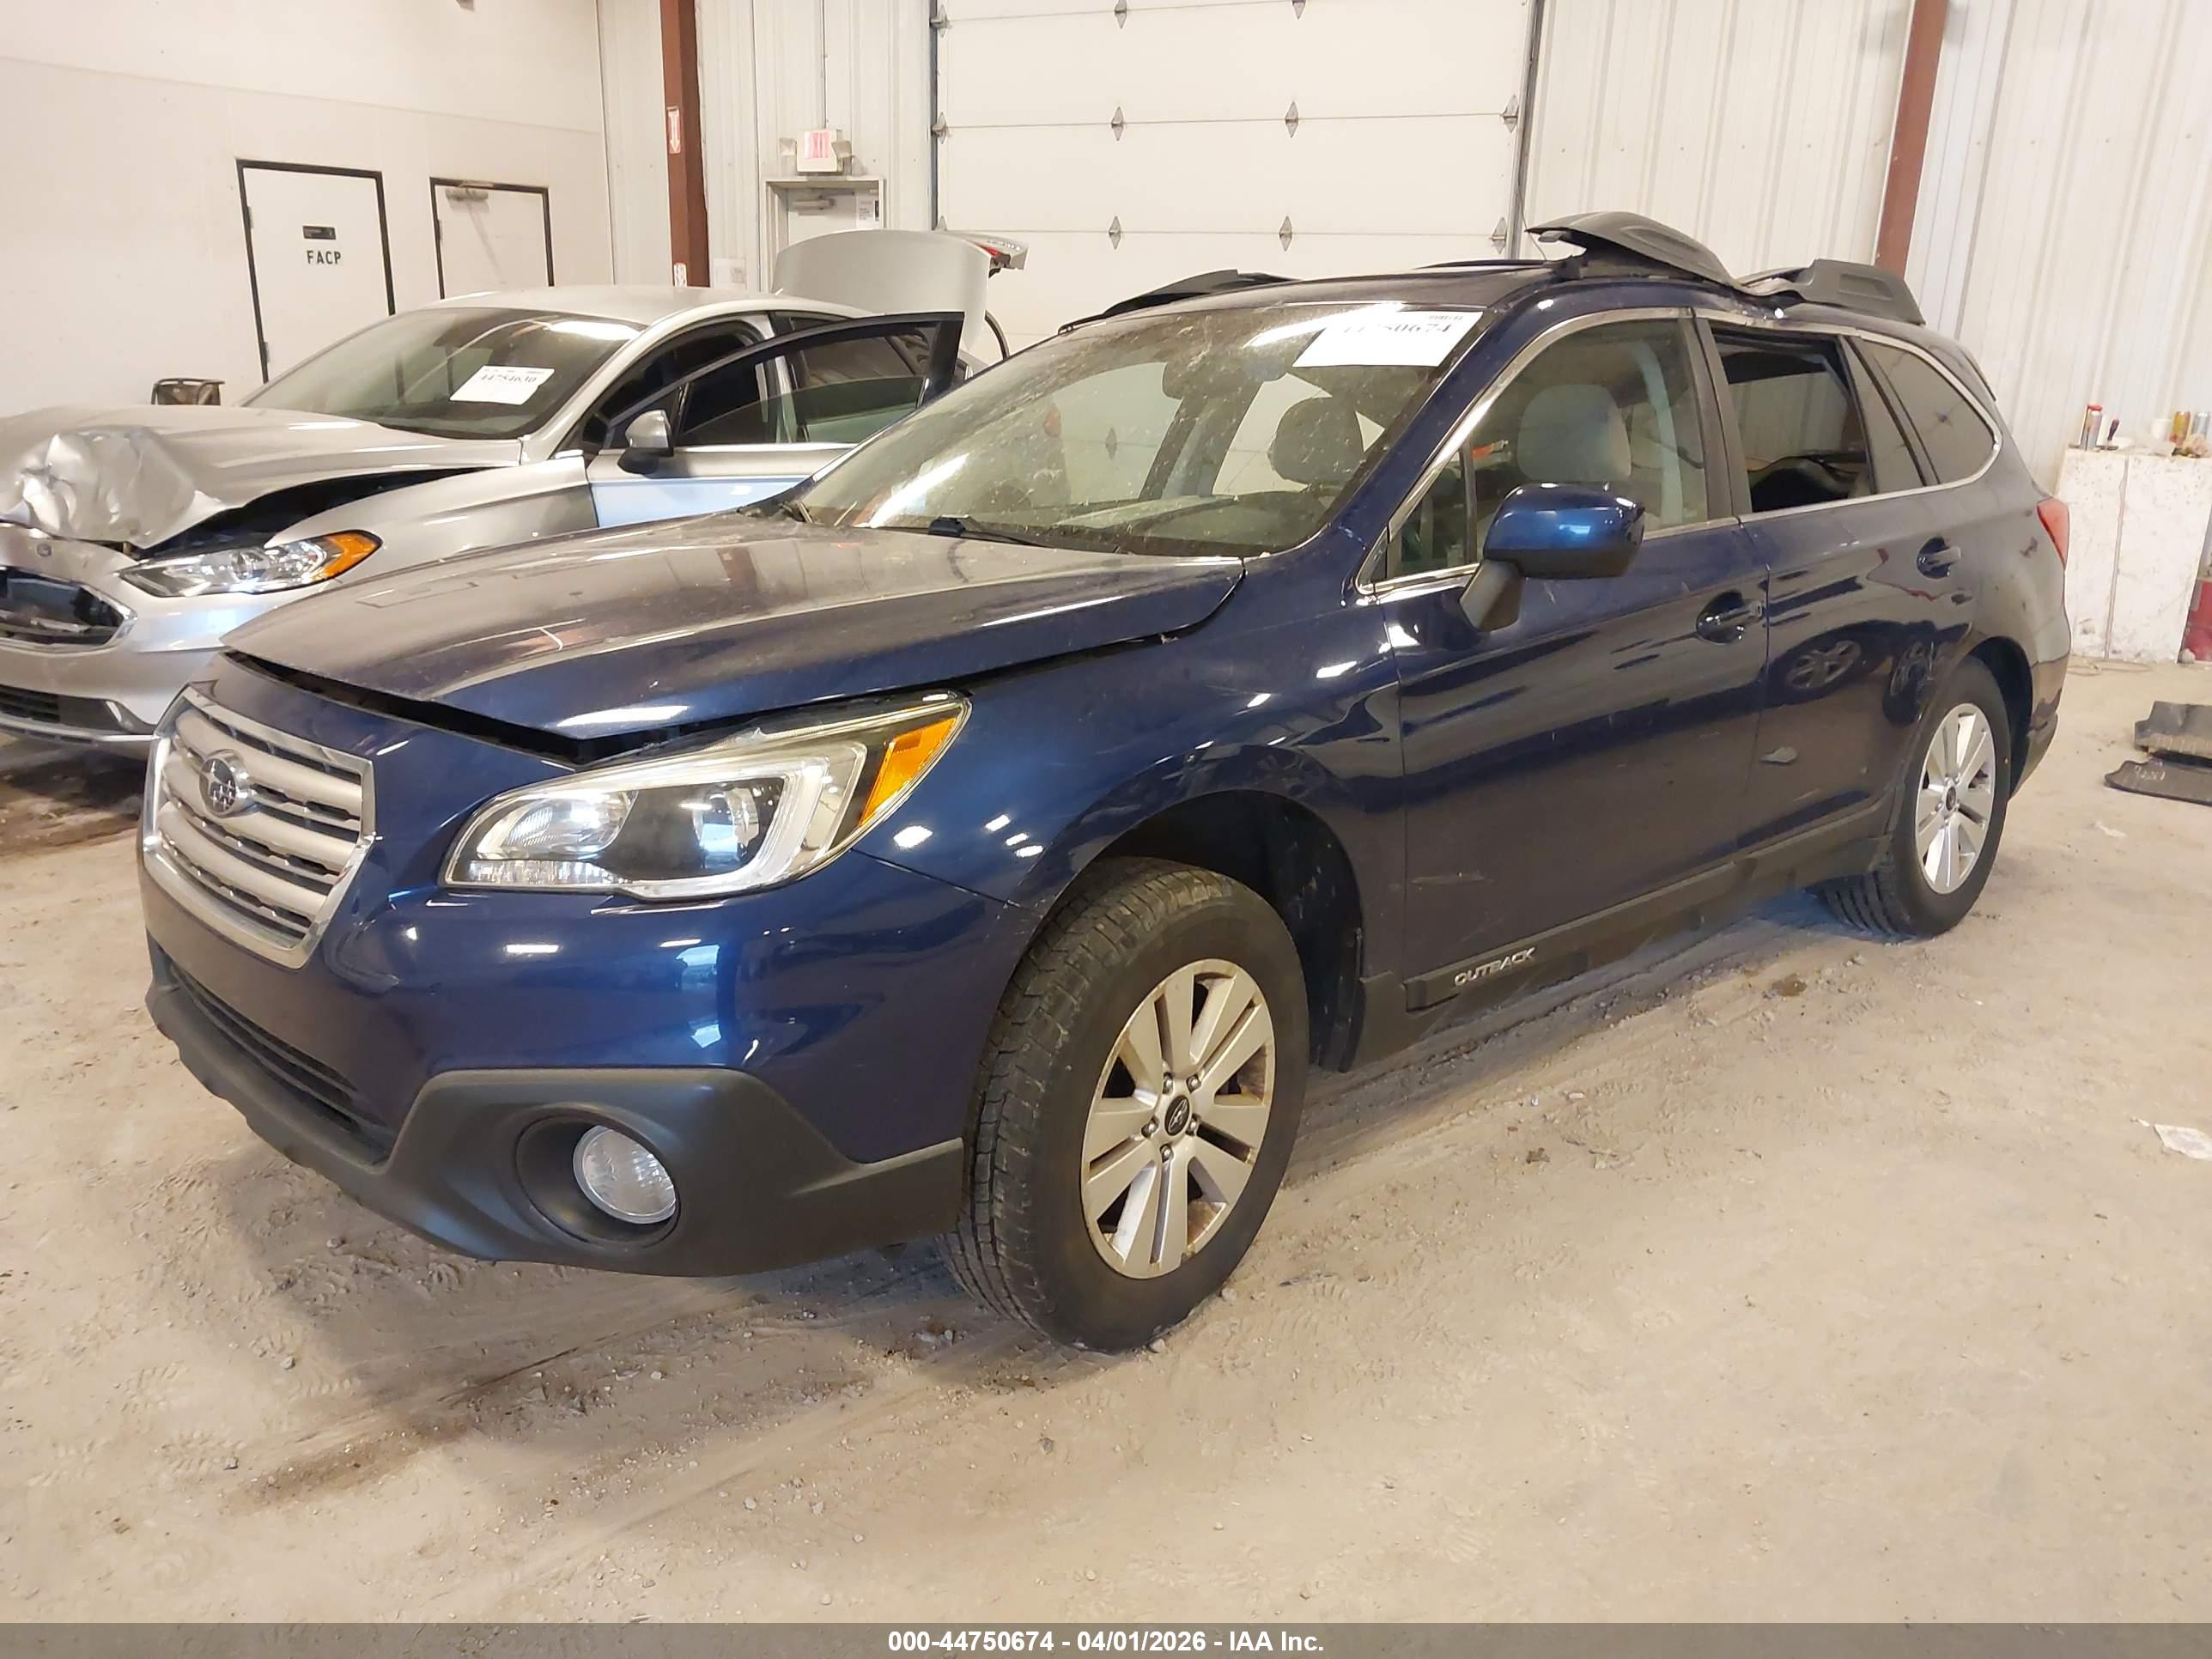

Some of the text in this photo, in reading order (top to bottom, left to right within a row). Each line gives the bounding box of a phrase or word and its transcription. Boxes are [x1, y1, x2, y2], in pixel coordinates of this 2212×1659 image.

[307, 250, 342, 264] FACP
[1340, 322, 1452, 333] 4450674
[1454, 946, 1536, 986] OUTBACK
